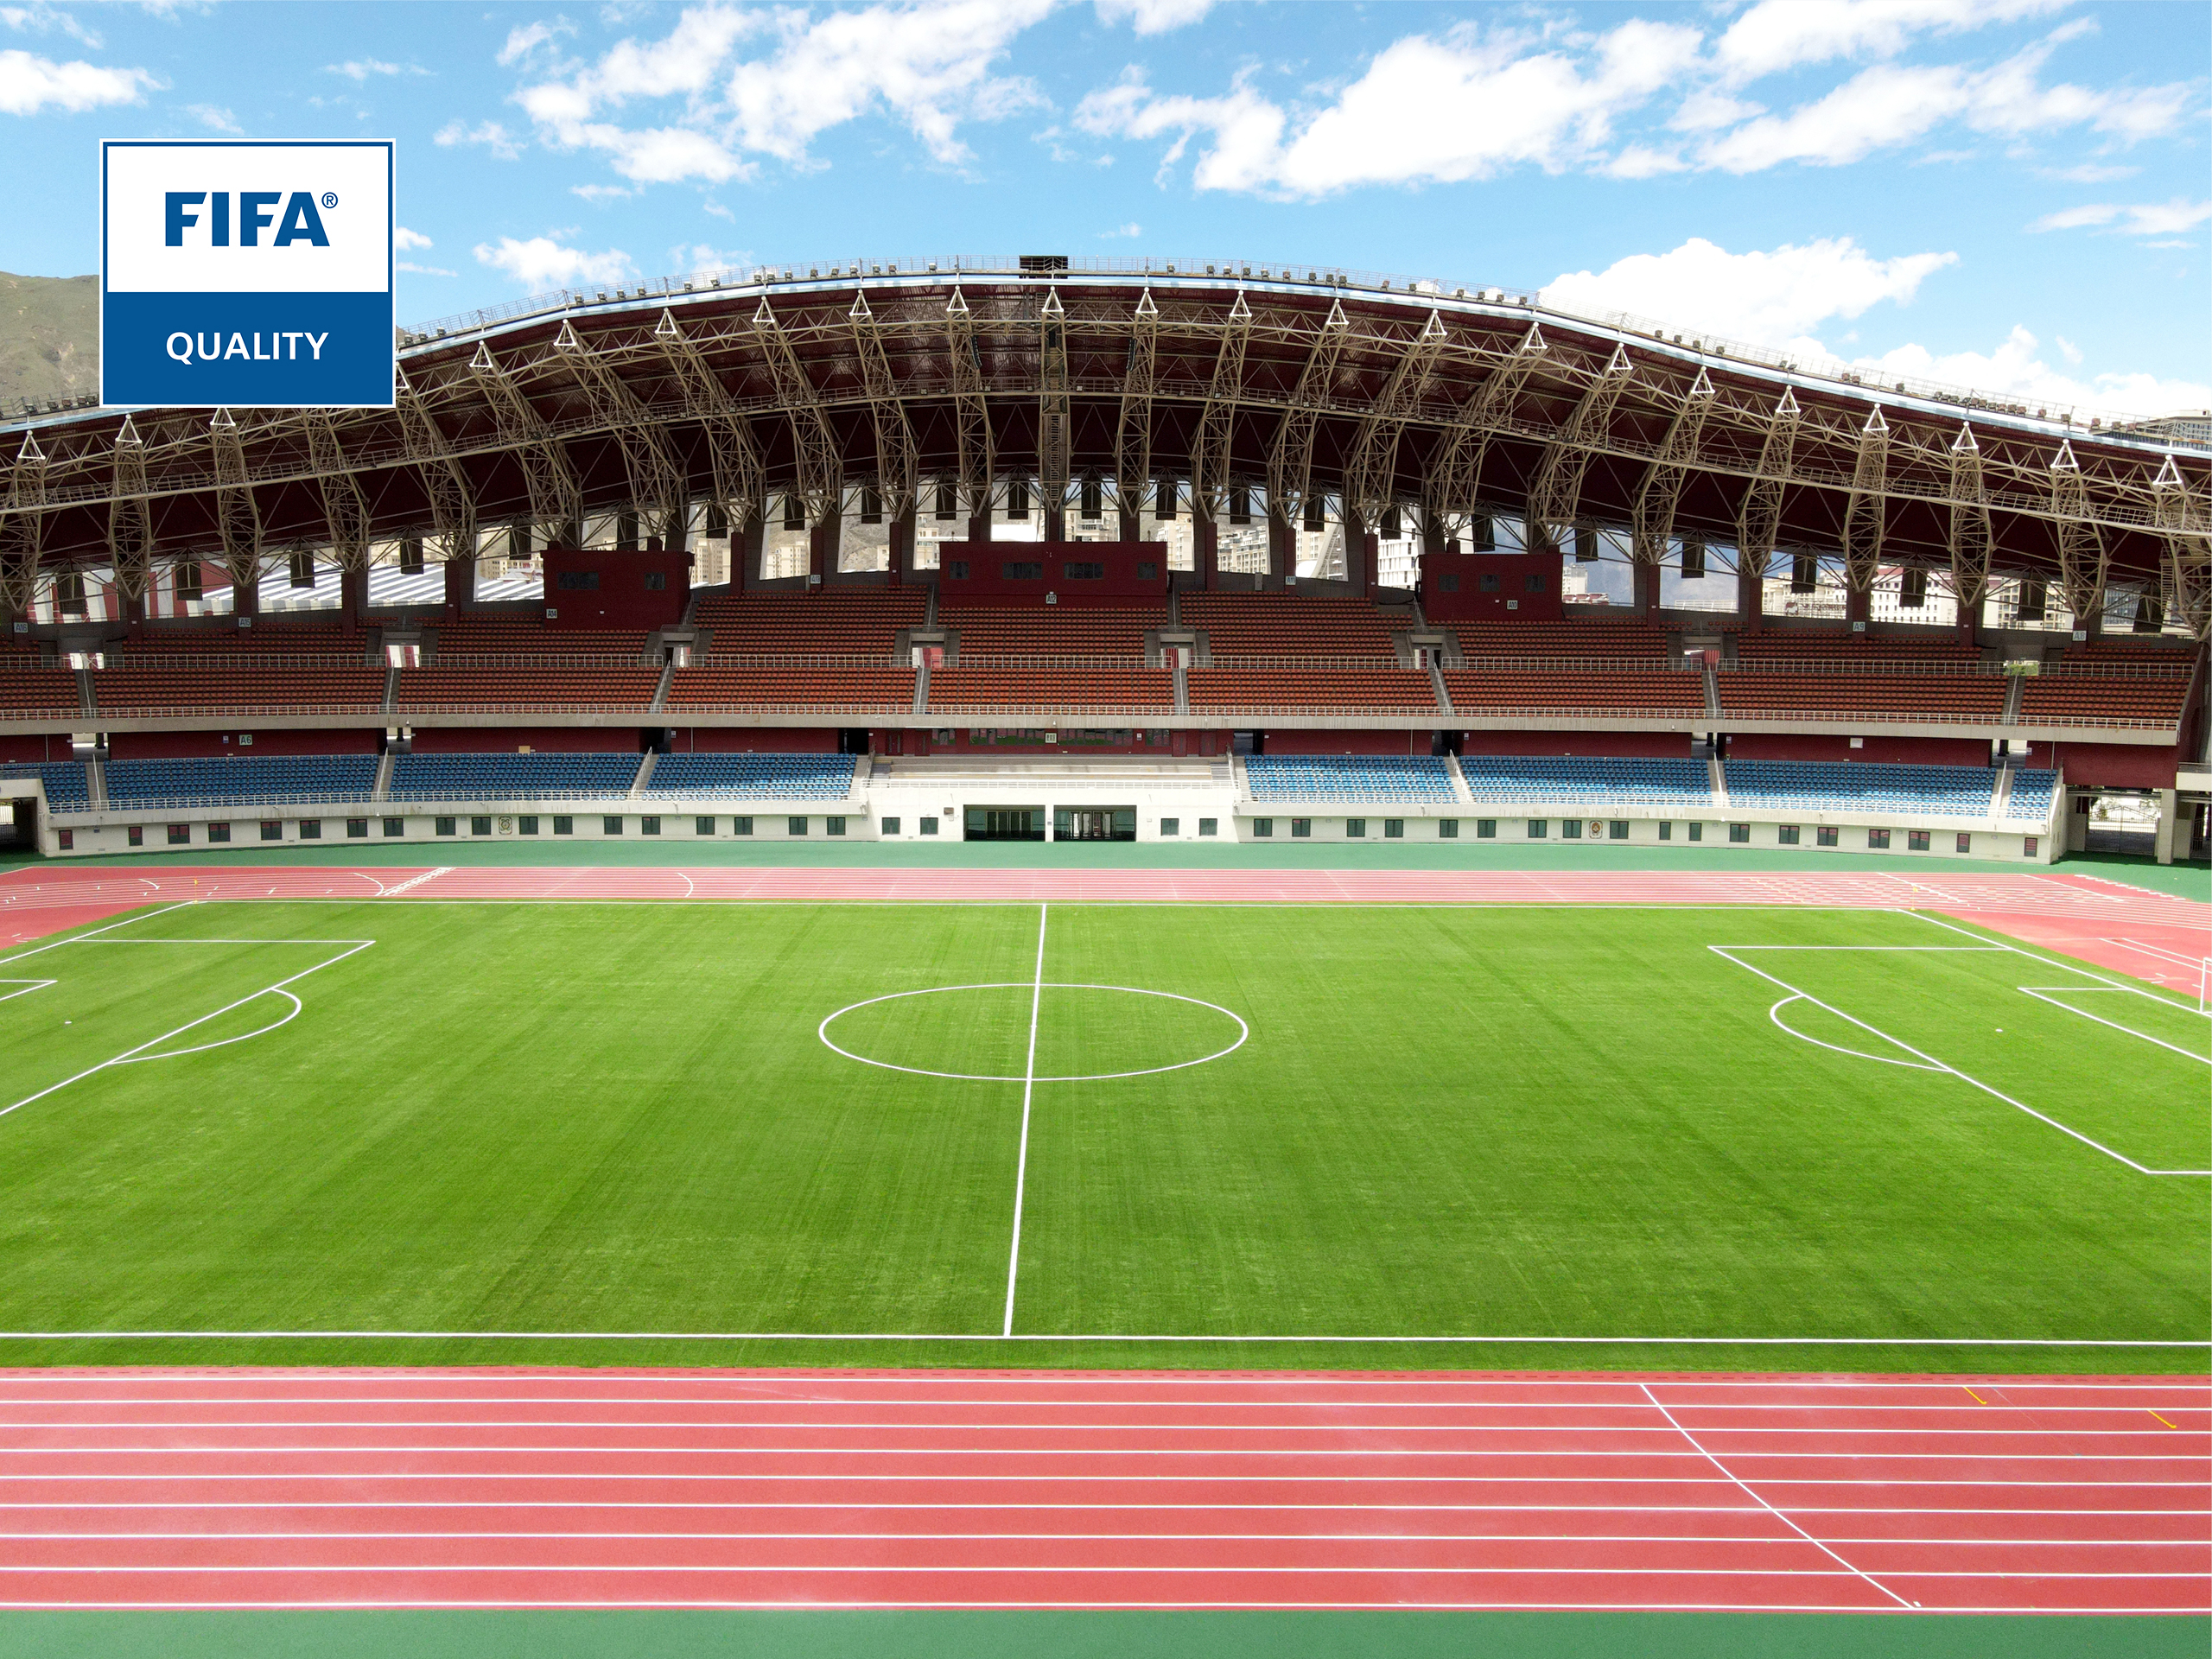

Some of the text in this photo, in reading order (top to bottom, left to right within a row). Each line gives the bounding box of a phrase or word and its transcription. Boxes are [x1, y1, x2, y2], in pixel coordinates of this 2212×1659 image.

[240, 618, 251, 626] A15
[1854, 622, 1864, 631] A9
[16, 624, 27, 632] A16
[2074, 631, 2085, 640] A8
[241, 735, 251, 744] A6
